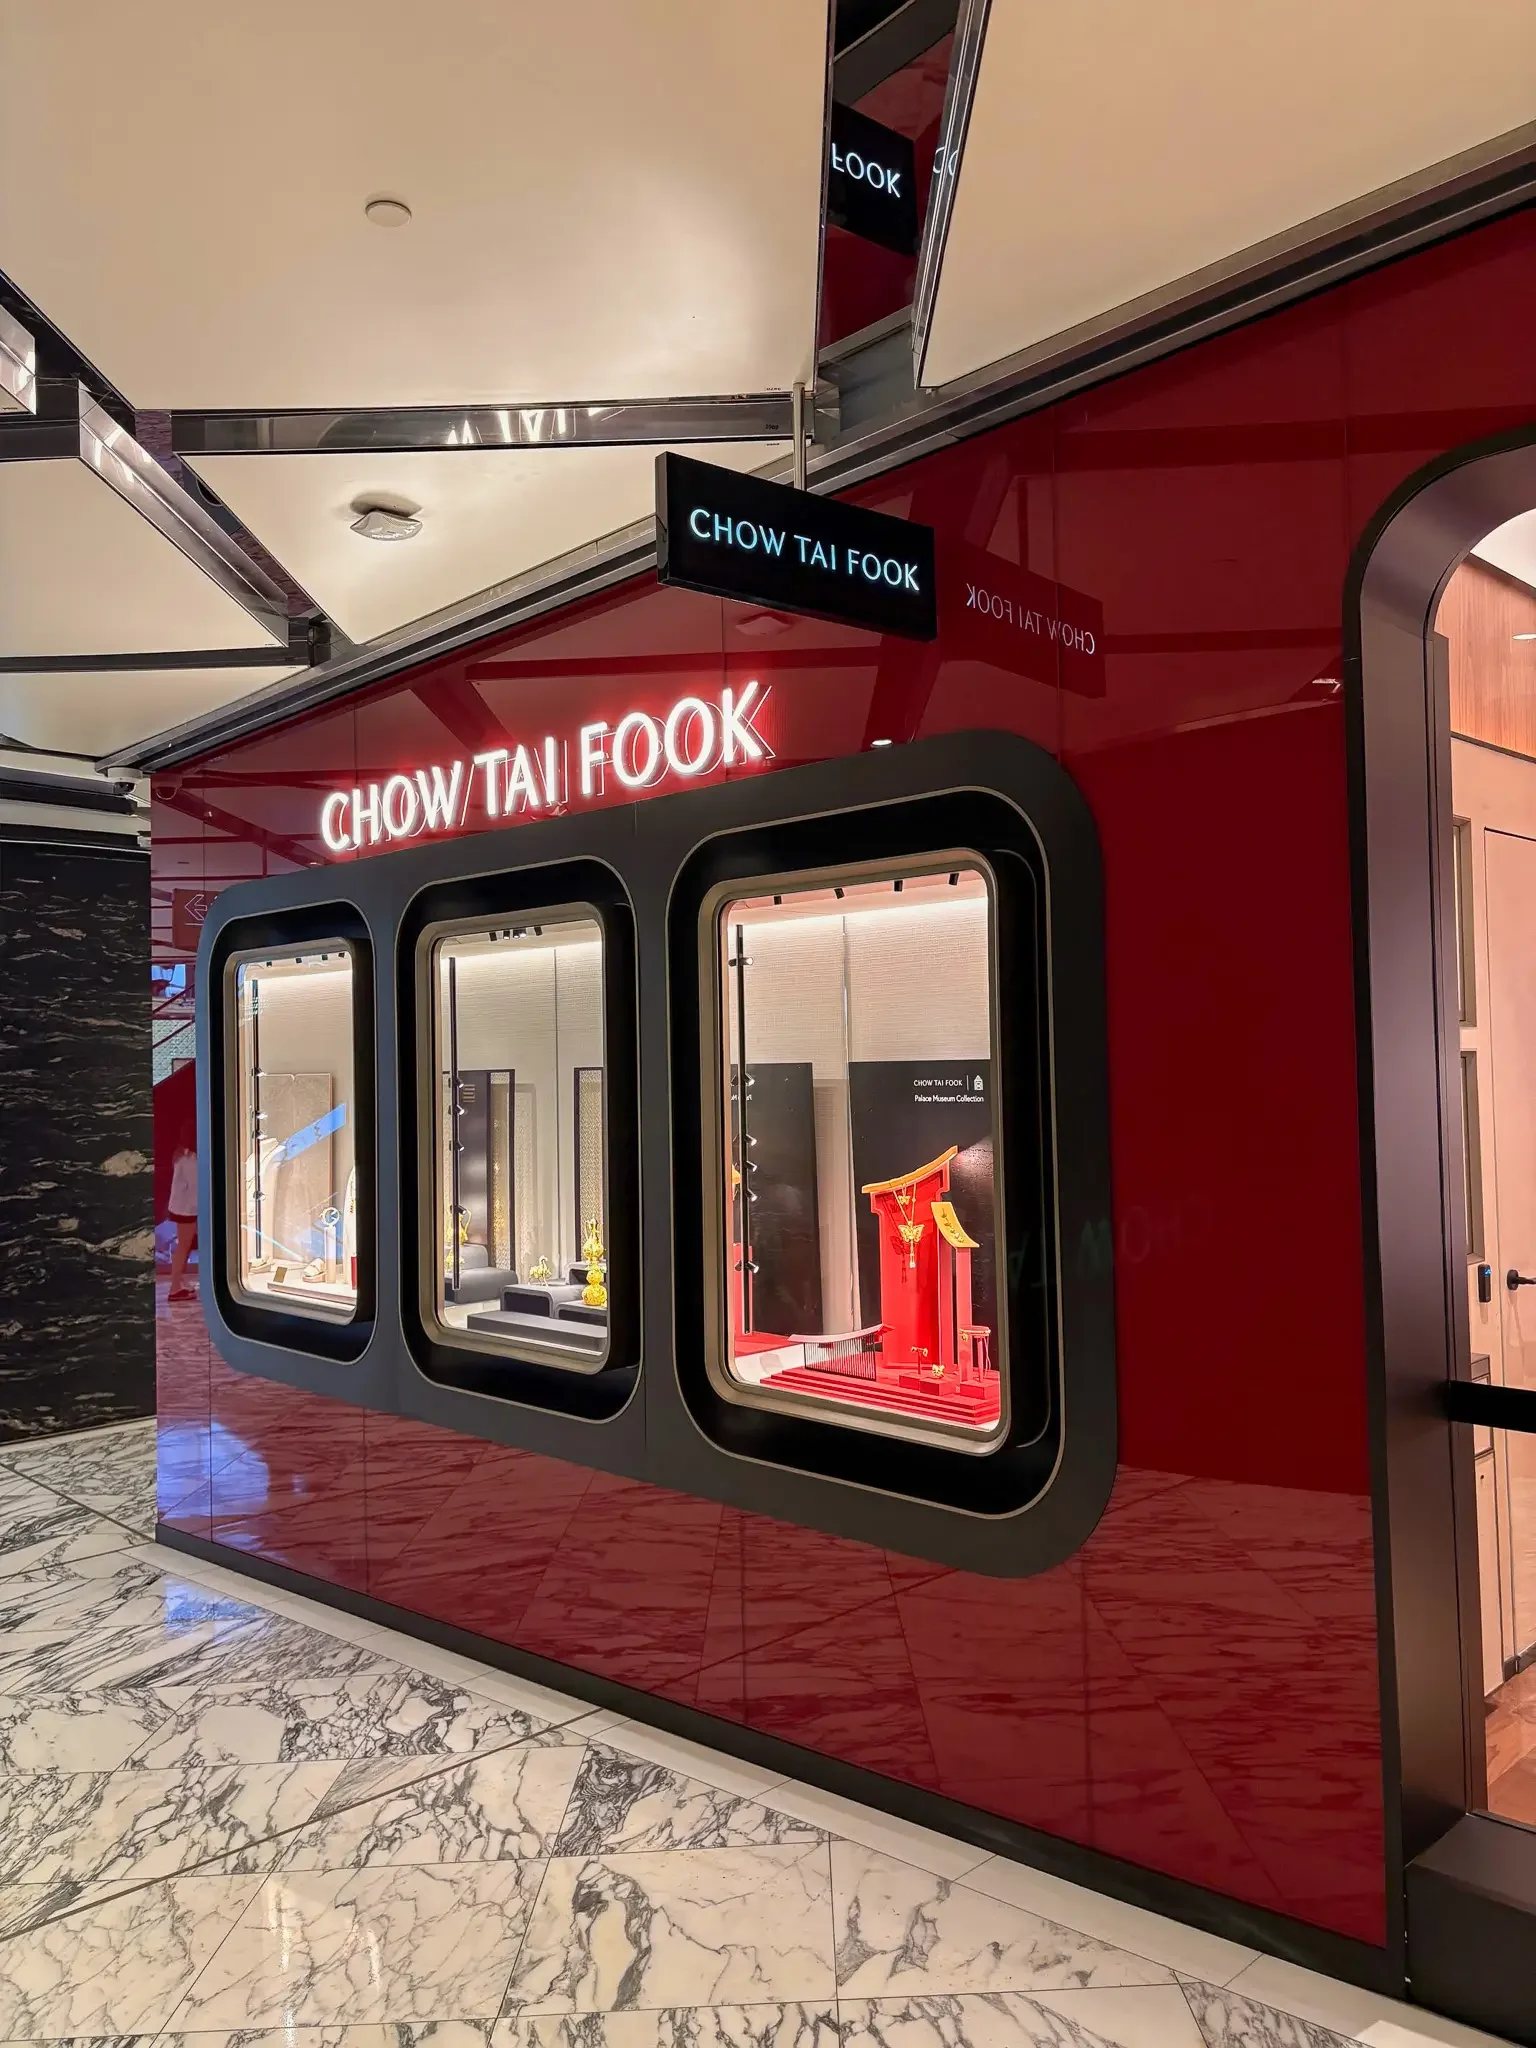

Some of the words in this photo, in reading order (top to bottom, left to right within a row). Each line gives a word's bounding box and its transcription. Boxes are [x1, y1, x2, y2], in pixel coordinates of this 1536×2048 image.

[689, 508, 786, 557] CHOW
[793, 534, 837, 571] TAI
[847, 548, 920, 591] FOOK
[321, 760, 464, 852] CHOW
[473, 735, 560, 816] TAI
[579, 680, 768, 797] FOOK
